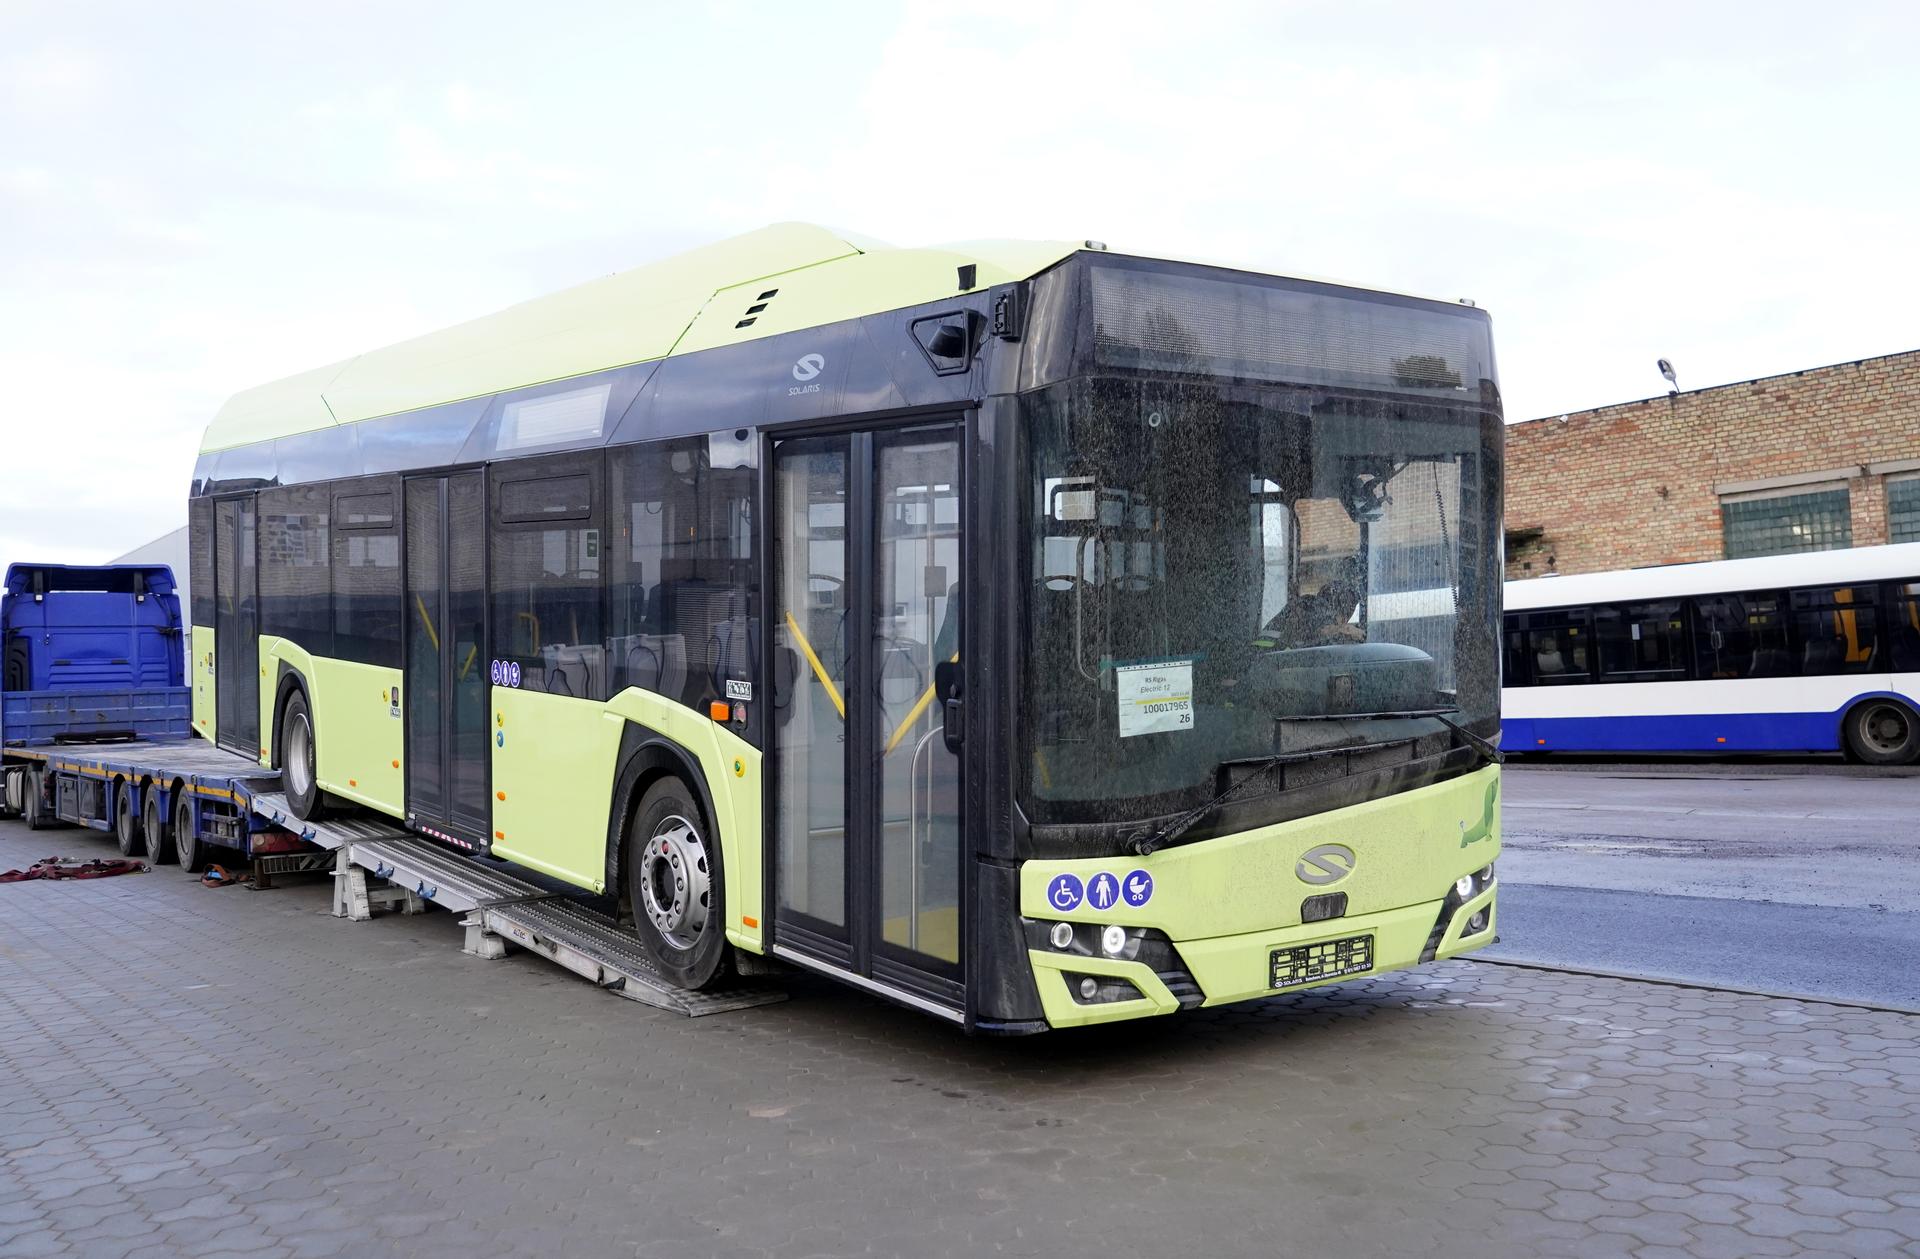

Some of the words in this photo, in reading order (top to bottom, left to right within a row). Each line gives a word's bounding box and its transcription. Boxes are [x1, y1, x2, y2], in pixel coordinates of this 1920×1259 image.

[788, 383, 820, 396] SOLARIS
[1144, 701, 1188, 714] 100017965
[1179, 714, 1191, 724] 26
